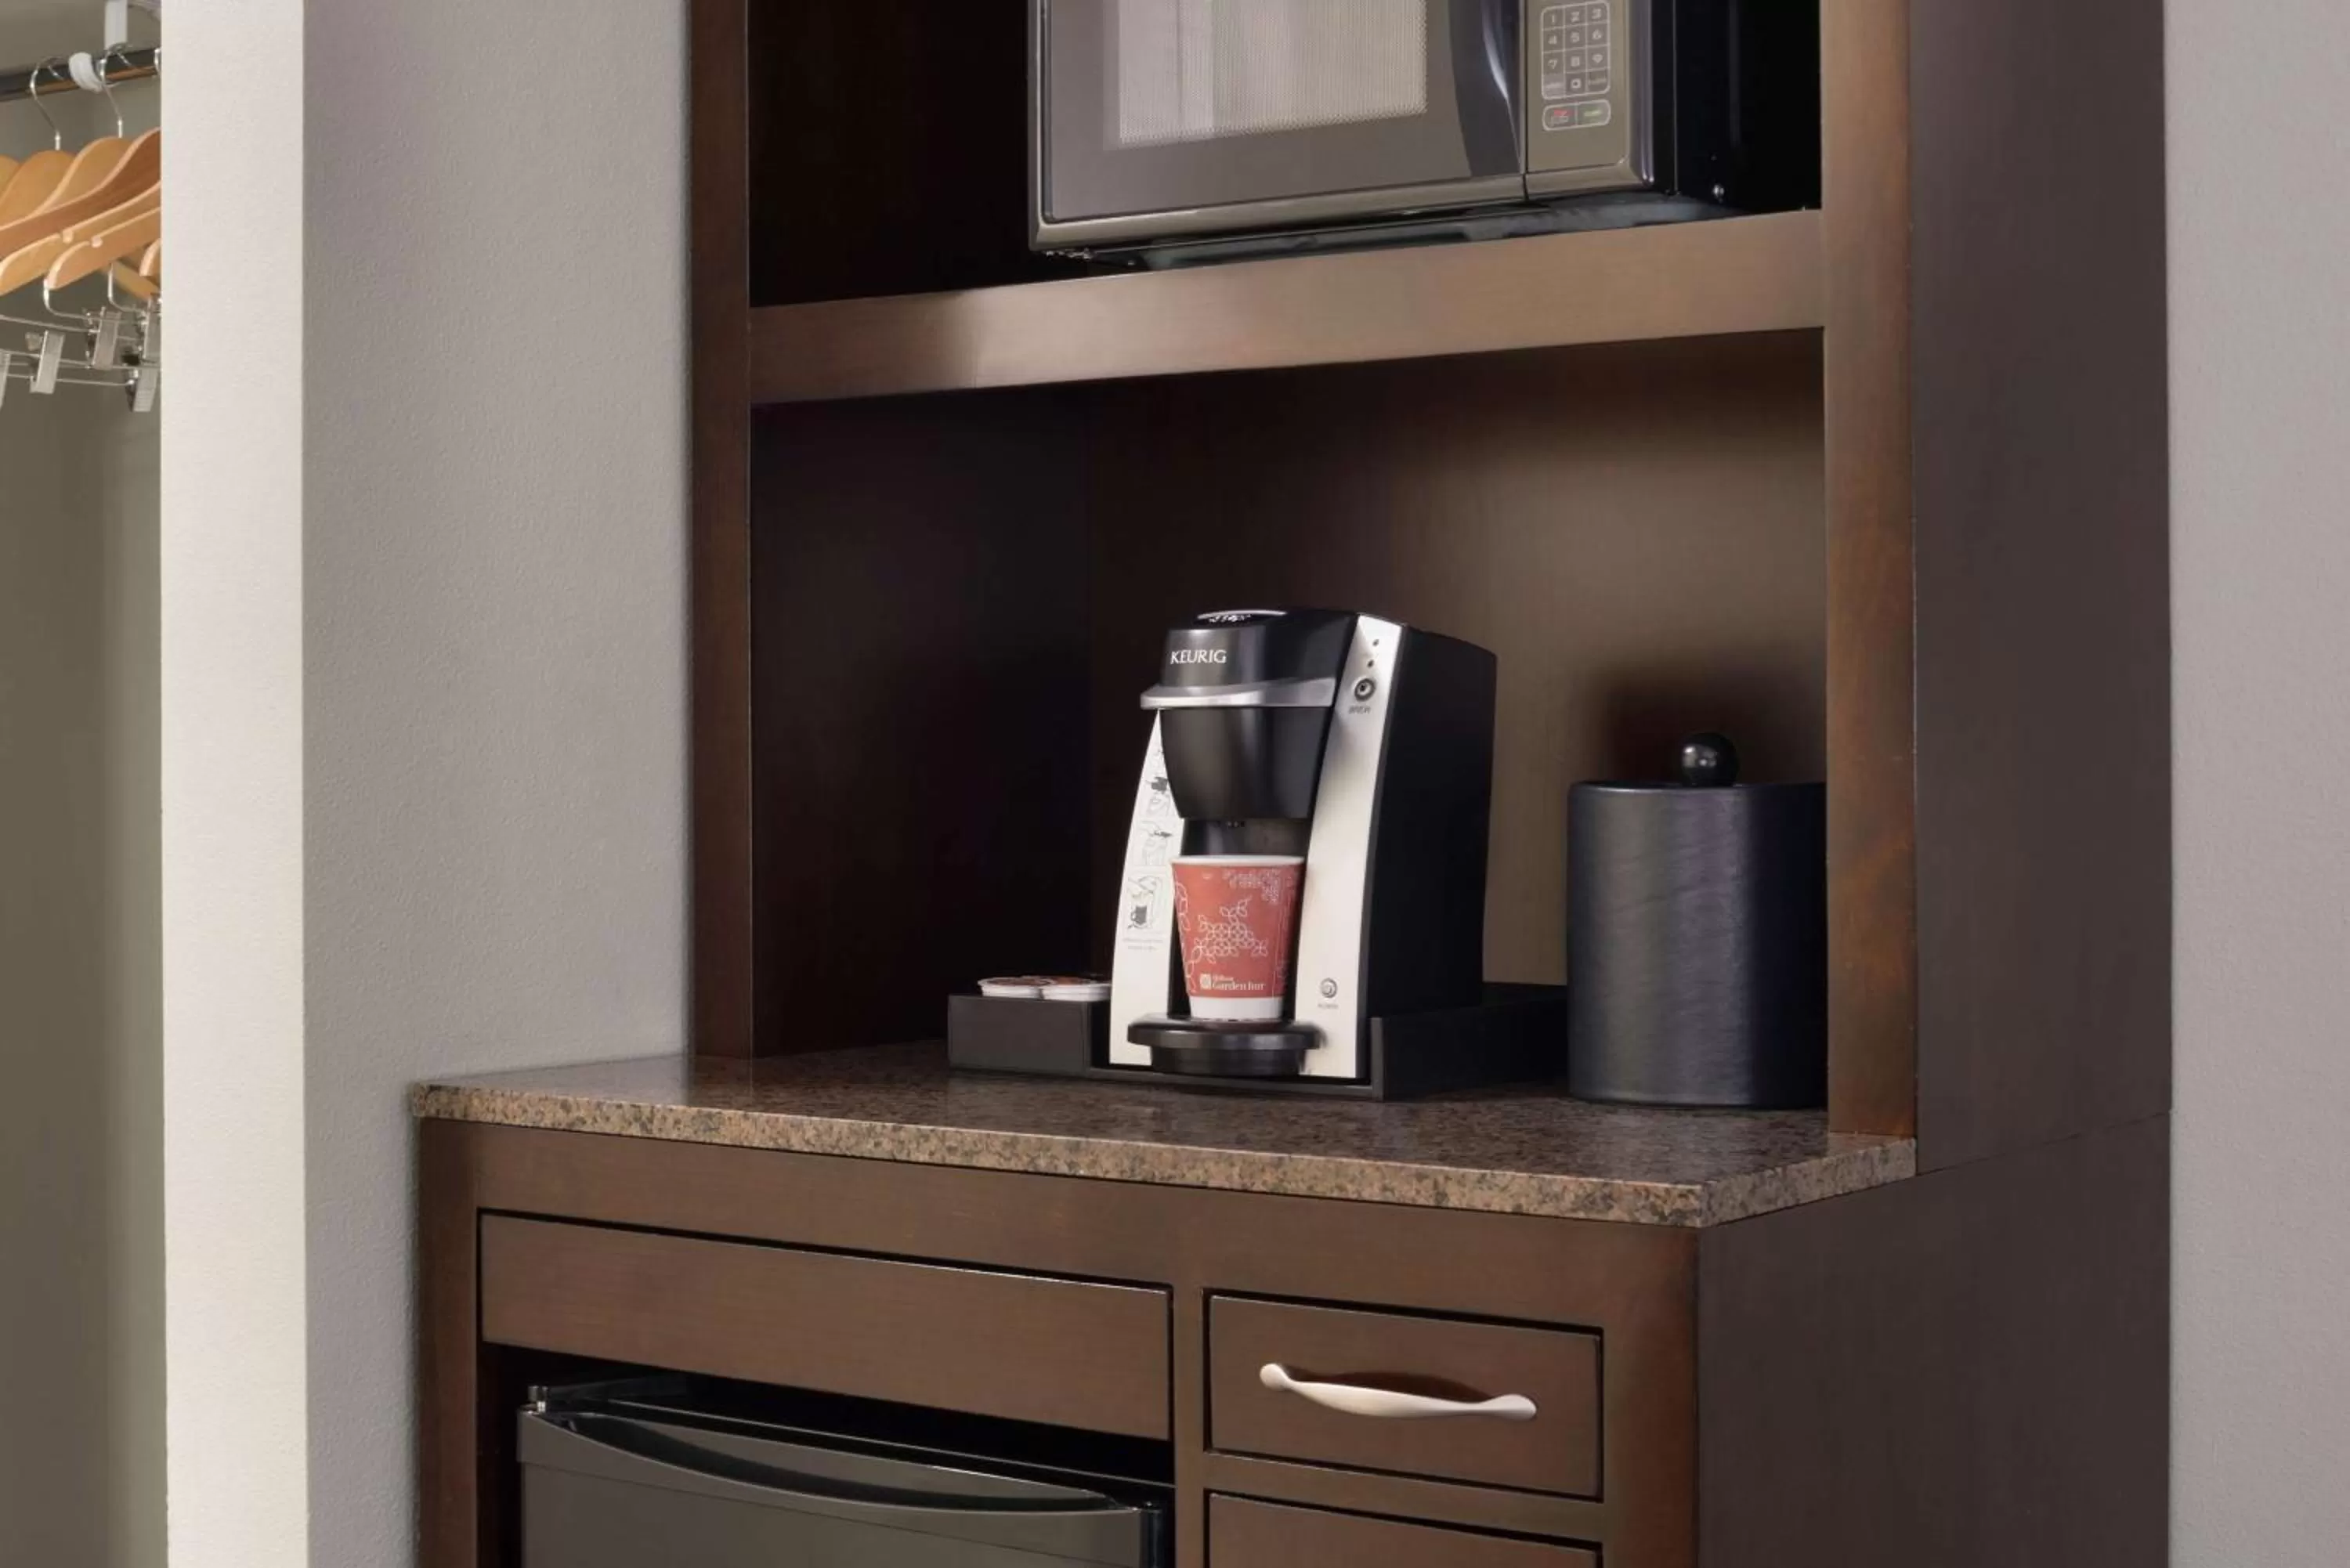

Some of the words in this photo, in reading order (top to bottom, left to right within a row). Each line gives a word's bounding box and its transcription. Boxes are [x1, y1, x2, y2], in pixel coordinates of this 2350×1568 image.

[1571, 11, 1581, 23] 2
[1591, 7, 1602, 20] 3
[1570, 31, 1580, 43] 5
[1591, 29, 1602, 40] 6
[1170, 649, 1227, 665] KEURIG
